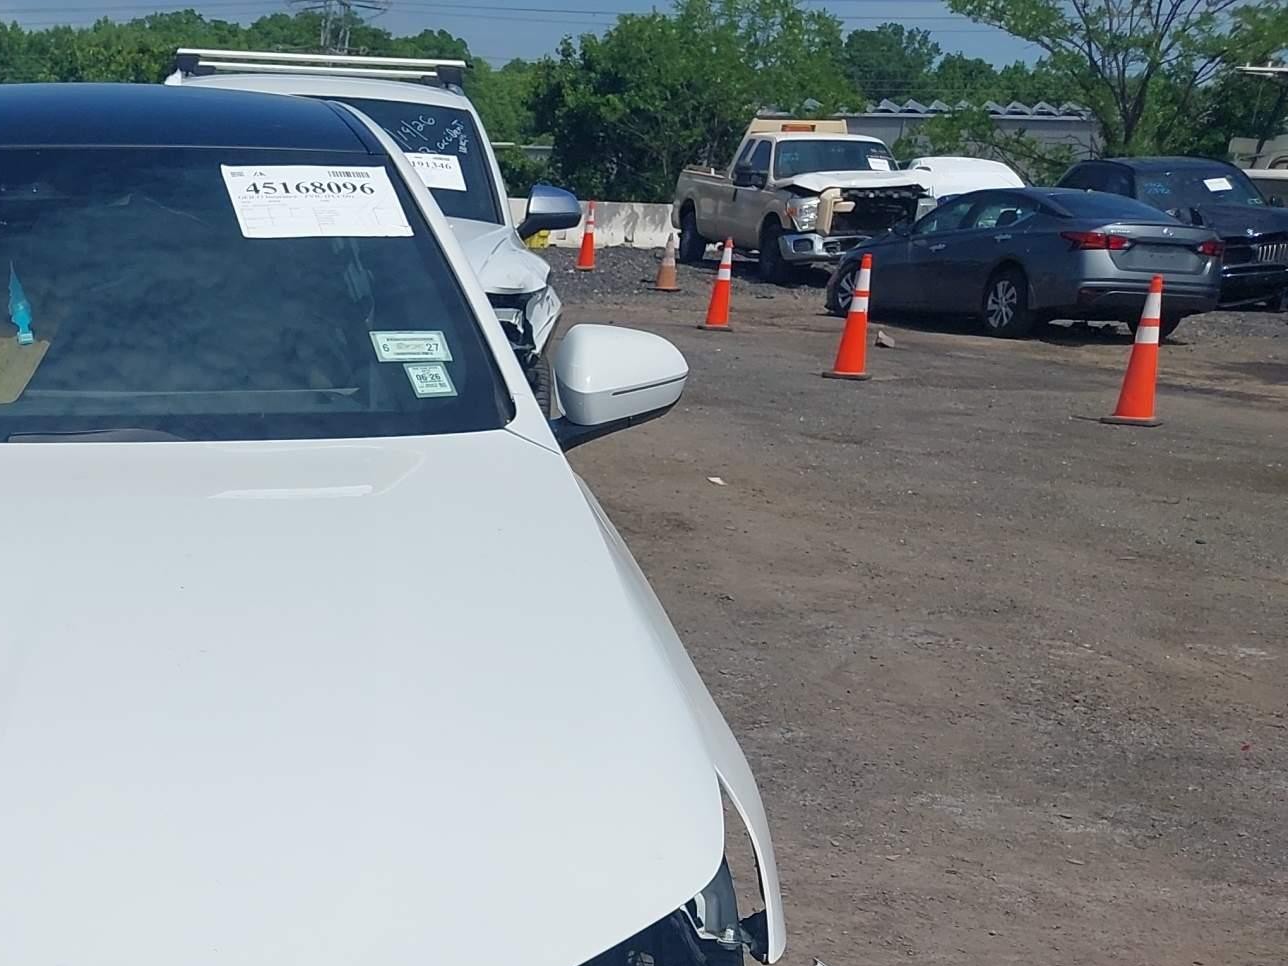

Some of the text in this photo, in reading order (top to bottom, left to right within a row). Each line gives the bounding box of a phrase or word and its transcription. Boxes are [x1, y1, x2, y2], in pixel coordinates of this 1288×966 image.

[245, 181, 376, 196] 45168096
[382, 343, 440, 353] 6 27
